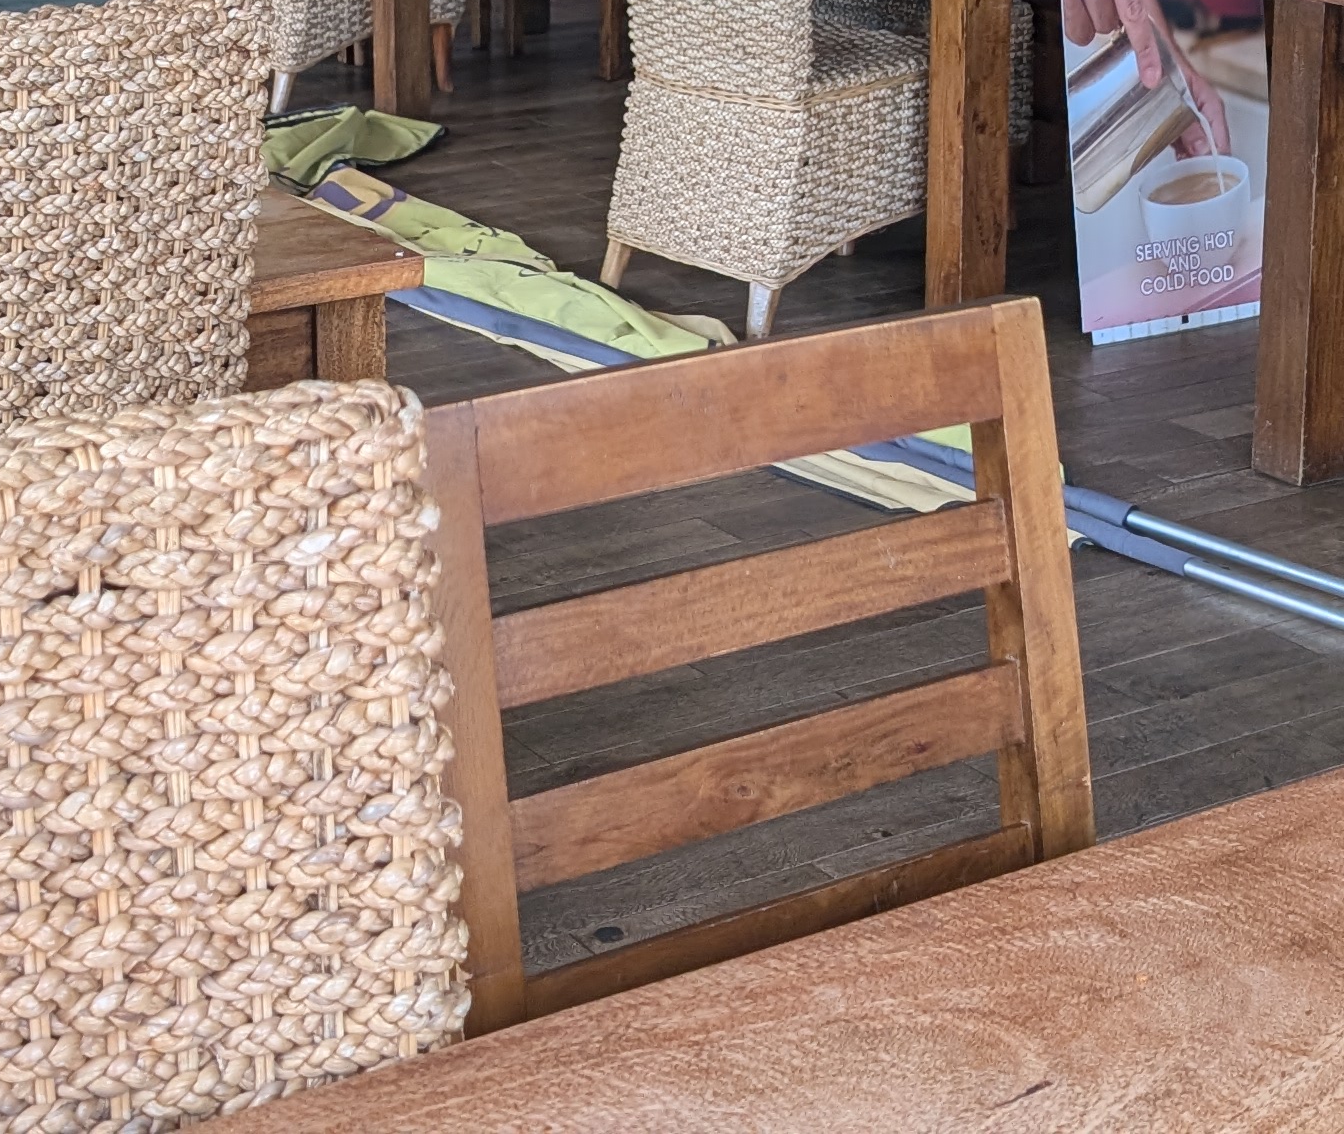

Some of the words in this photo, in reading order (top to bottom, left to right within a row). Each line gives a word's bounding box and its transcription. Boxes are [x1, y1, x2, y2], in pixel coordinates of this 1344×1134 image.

[1136, 235, 1200, 262] SERVING
[1204, 229, 1235, 252] HOT
[1168, 253, 1201, 274] AND
[1140, 273, 1185, 296] COLD
[1190, 265, 1235, 288] FOOD
